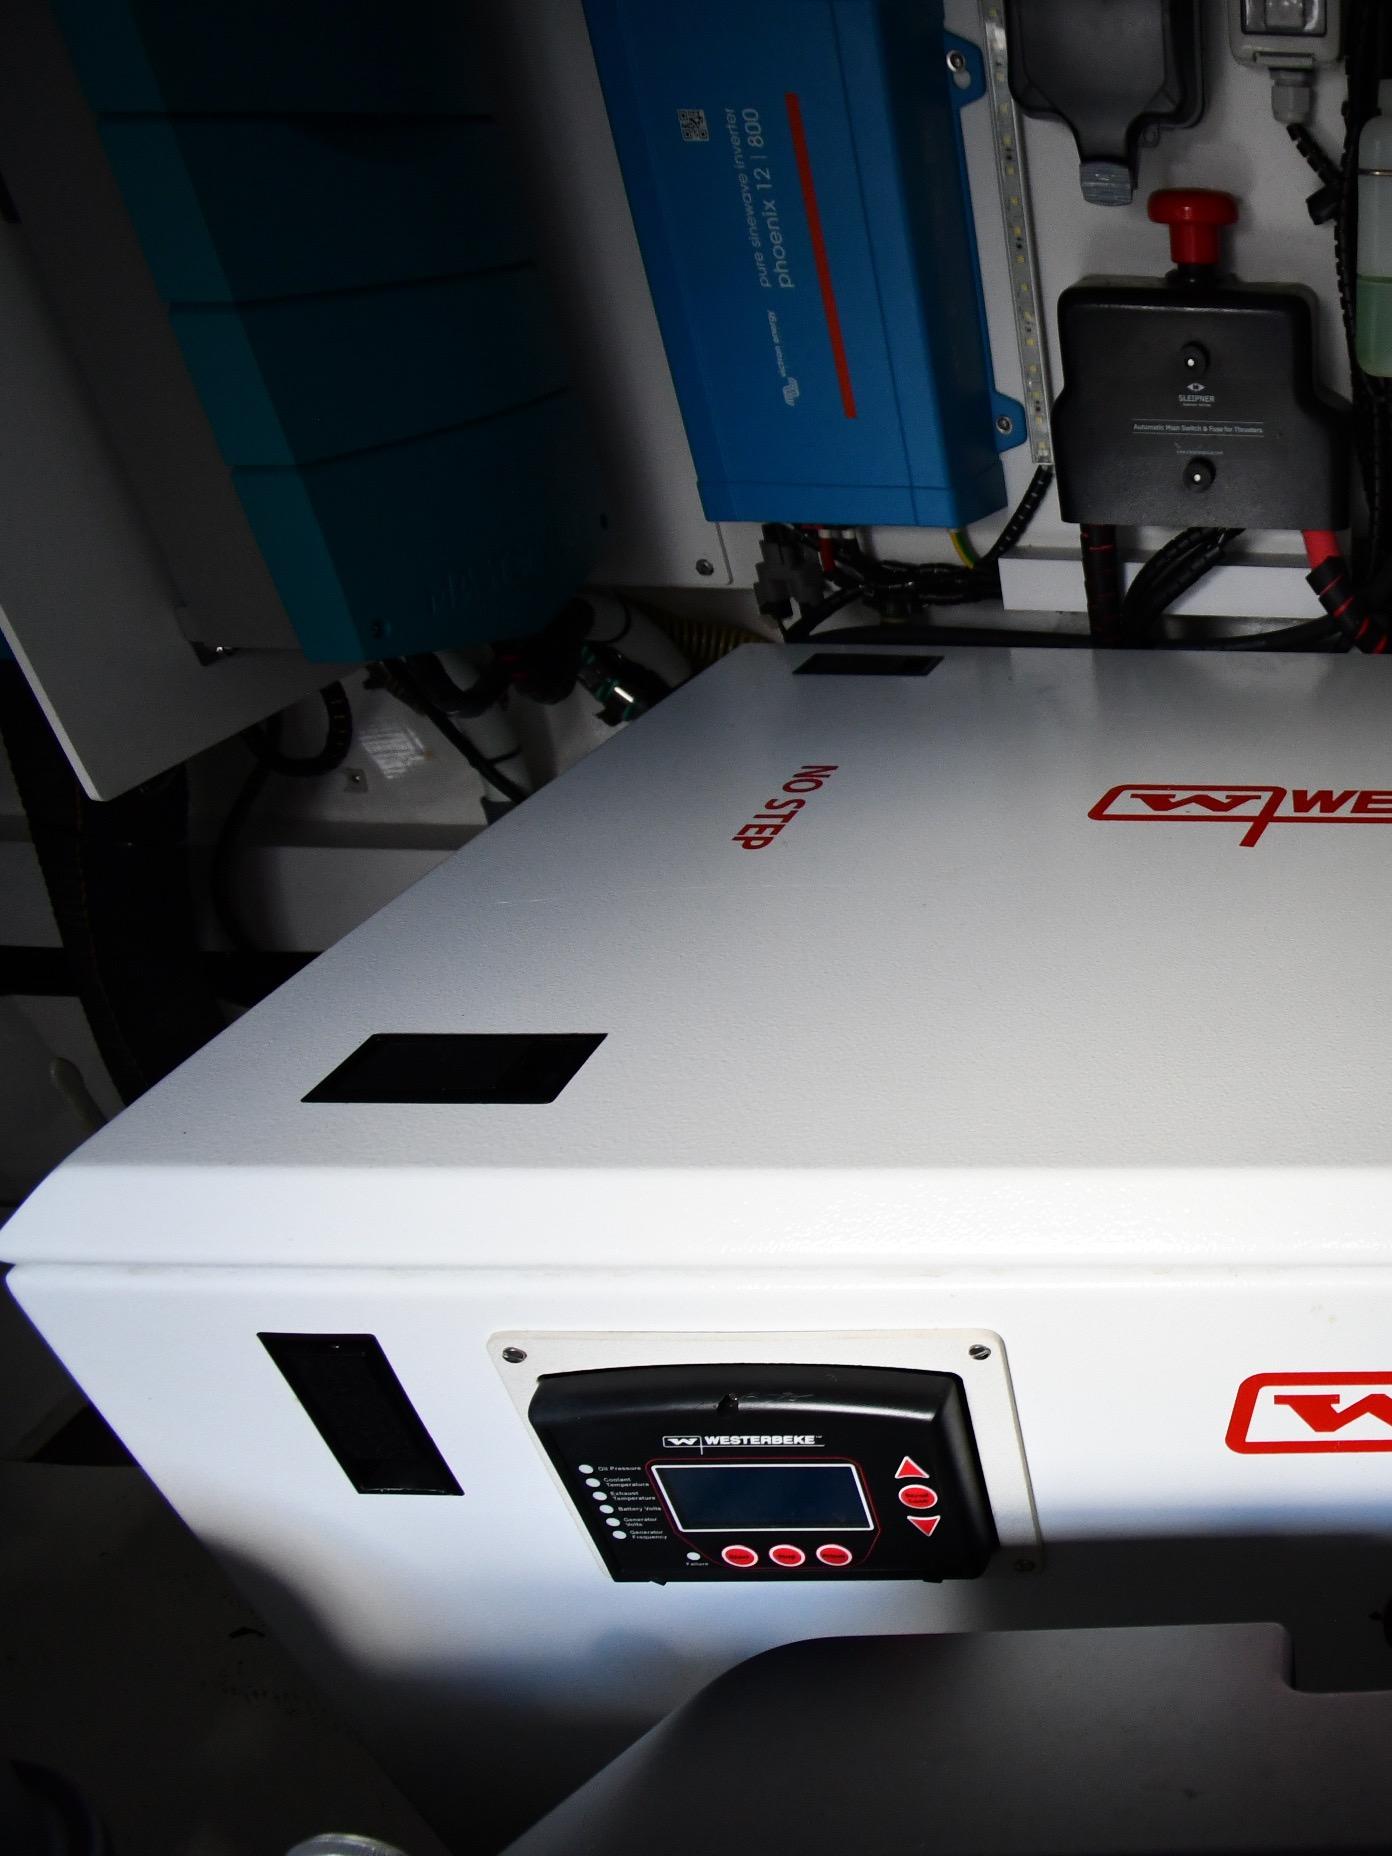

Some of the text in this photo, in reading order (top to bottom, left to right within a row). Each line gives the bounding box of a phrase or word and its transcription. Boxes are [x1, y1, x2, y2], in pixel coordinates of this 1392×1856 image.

[741, 107, 766, 149] 800
[723, 106, 772, 289] pure sinewave inverter
[753, 166, 773, 191] 12
[761, 199, 795, 289] phoenix
[1178, 394, 1215, 403] SLEIPNER
[731, 765, 840, 850] NO STEP
[704, 1435, 816, 1446] WESTERBEKE
